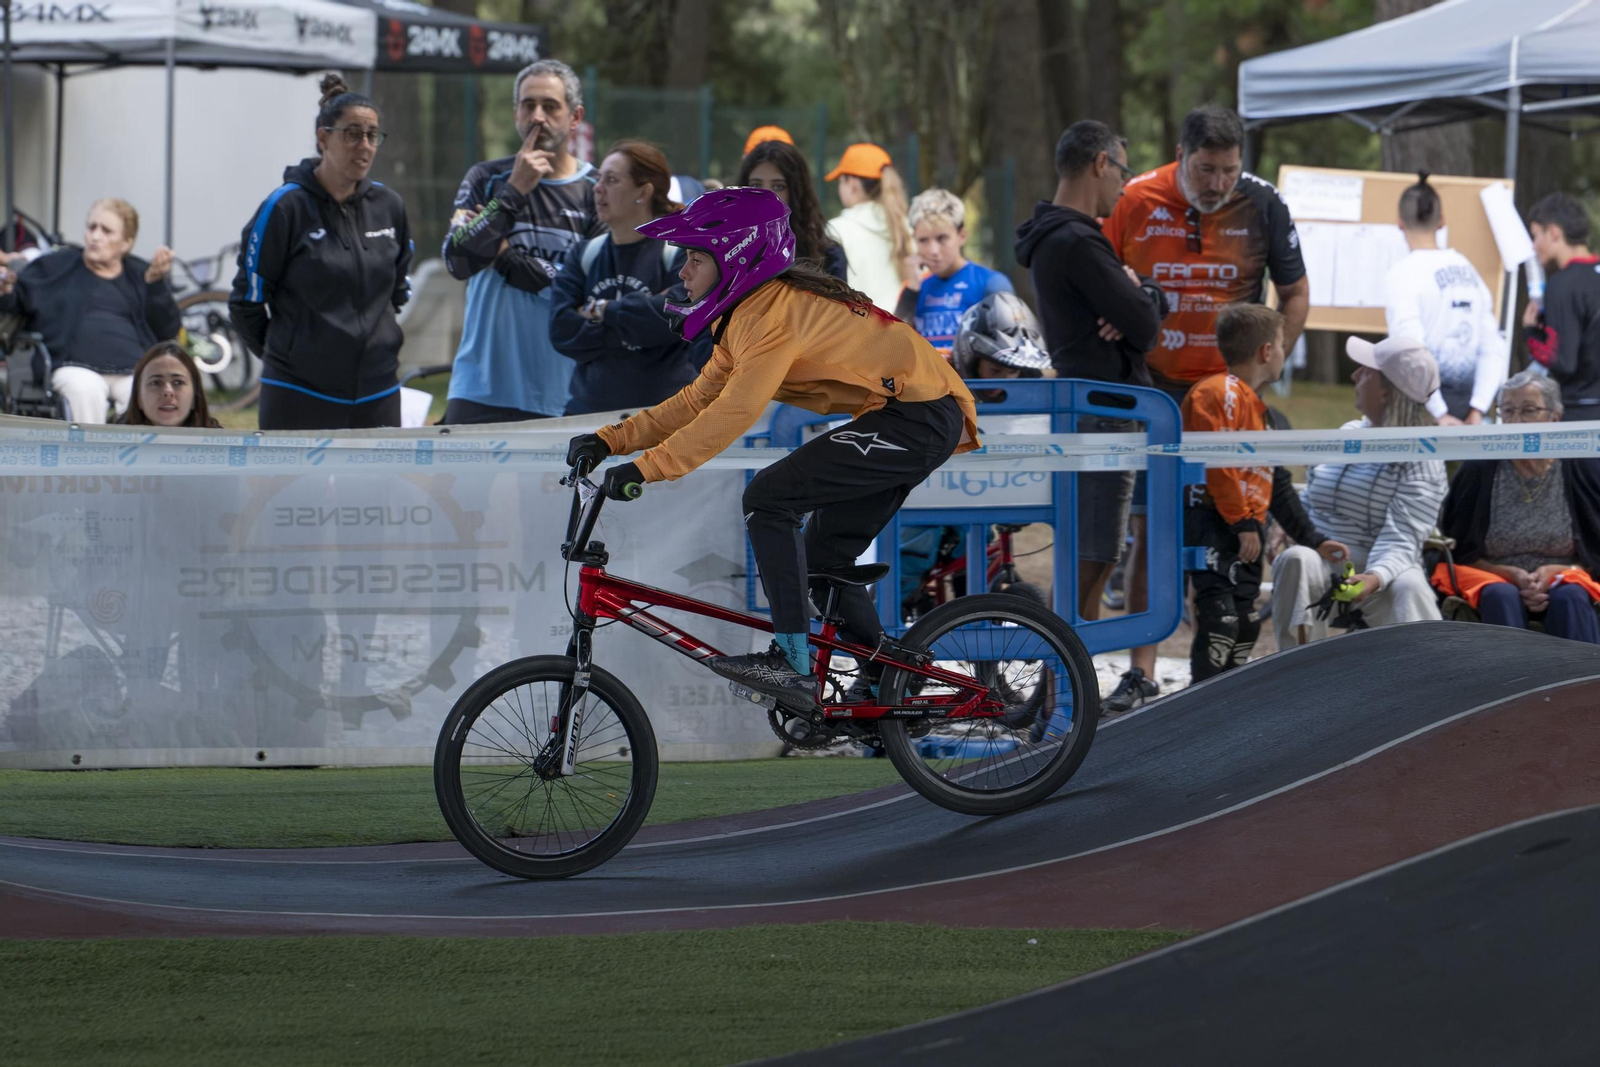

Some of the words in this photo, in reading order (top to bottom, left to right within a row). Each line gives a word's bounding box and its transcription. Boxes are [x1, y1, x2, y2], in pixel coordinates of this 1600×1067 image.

[1135, 224, 1186, 241] galicia
[724, 225, 758, 262] KENNY
[1364, 444, 1409, 452] DEPORTE
[1482, 442, 1520, 452] XUNTA
[1543, 442, 1589, 451] DEPORTE
